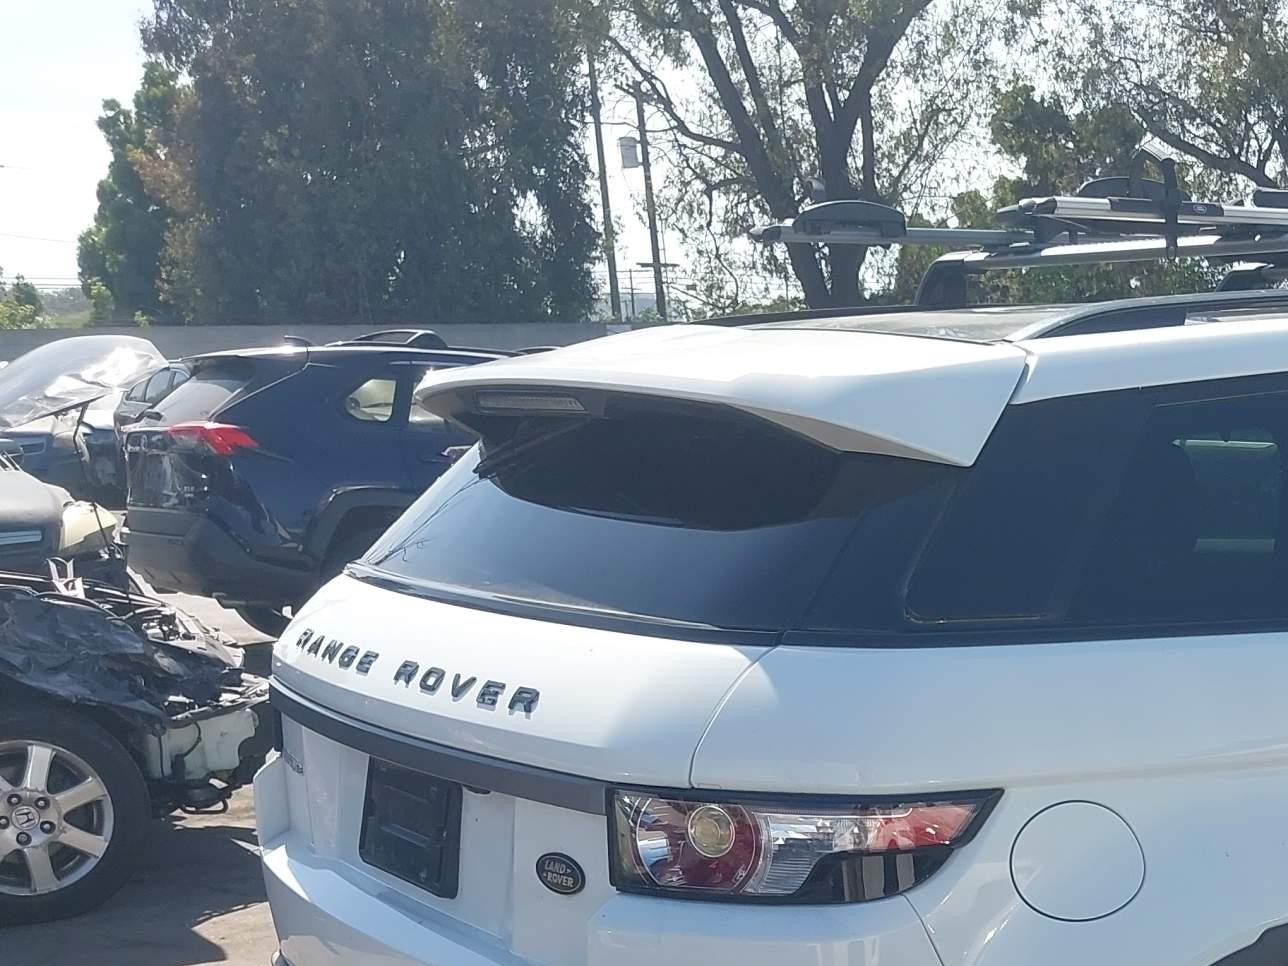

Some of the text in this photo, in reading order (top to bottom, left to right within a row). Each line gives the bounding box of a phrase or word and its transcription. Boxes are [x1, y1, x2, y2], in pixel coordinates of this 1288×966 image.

[295, 628, 541, 717] RANGE ROVER
[544, 859, 567, 874] LAND
[546, 871, 575, 888] ROVER
